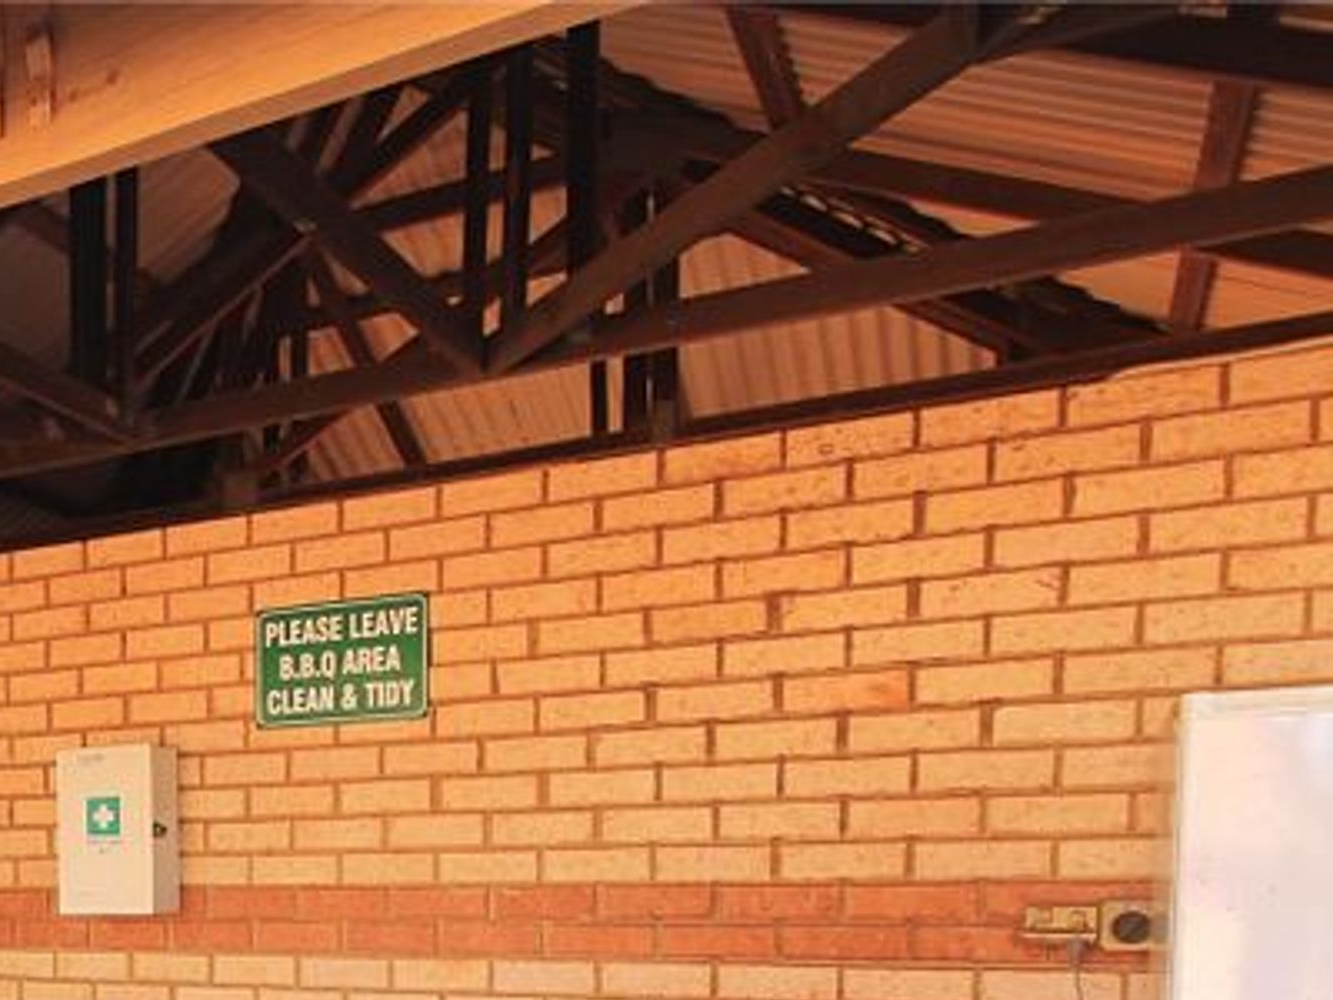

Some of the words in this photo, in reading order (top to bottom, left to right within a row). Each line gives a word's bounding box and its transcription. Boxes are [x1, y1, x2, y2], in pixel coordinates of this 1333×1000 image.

[266, 615, 343, 647] PLEASE
[349, 606, 418, 638] LEAVE
[279, 650, 337, 680] B.B.Q
[343, 644, 401, 675] AREA
[268, 684, 334, 714] CLEAN
[340, 683, 358, 709] &
[365, 678, 414, 707] TIDY
